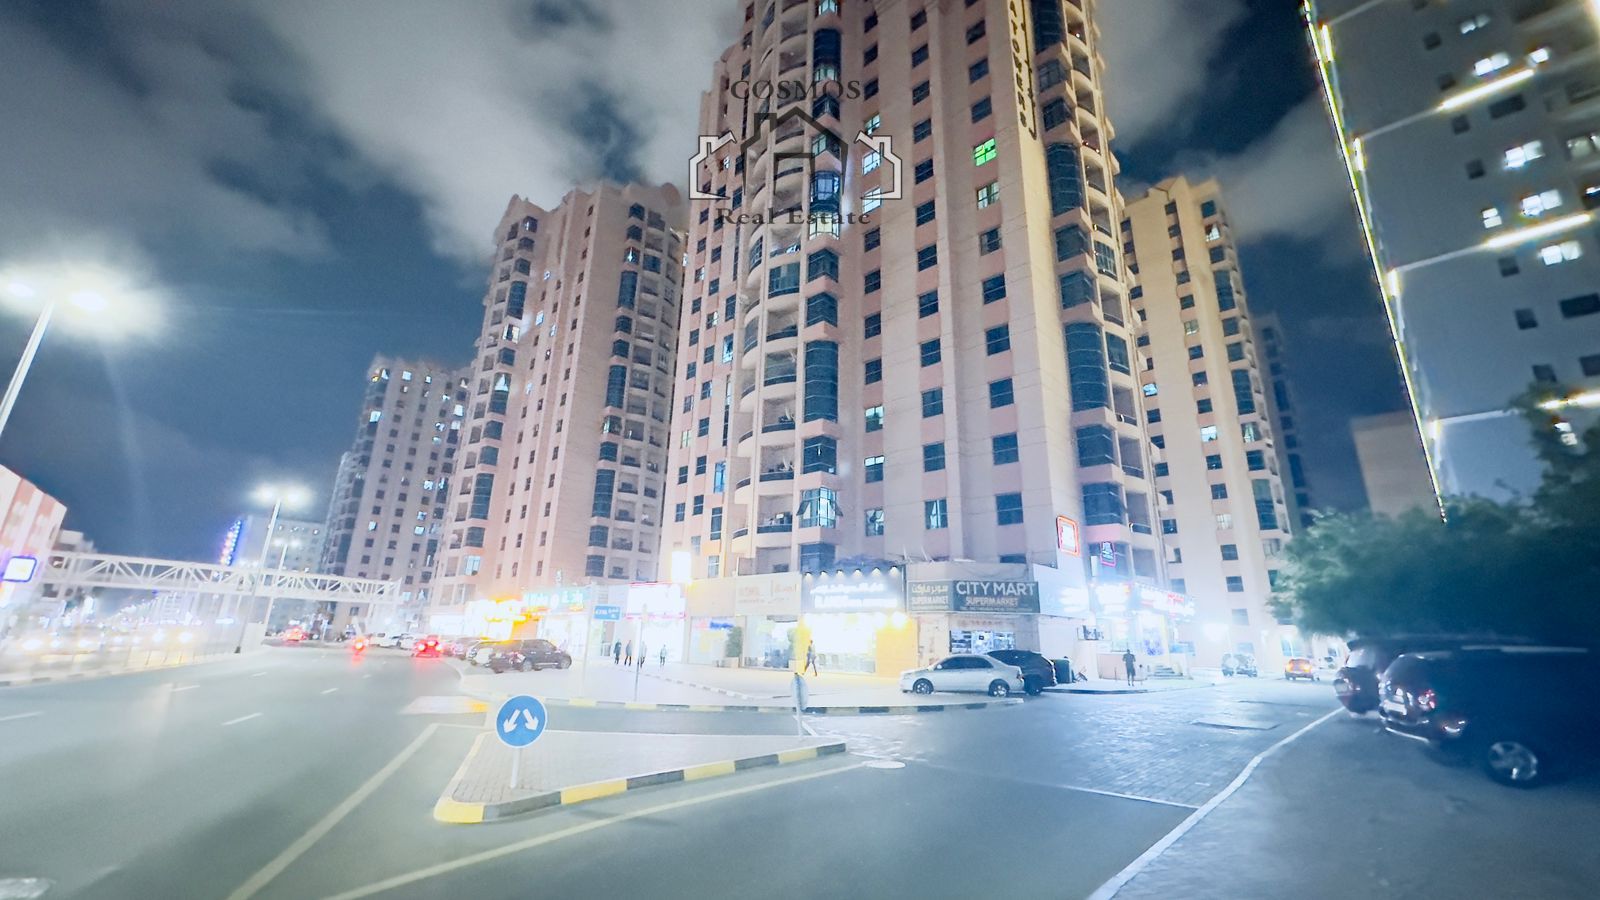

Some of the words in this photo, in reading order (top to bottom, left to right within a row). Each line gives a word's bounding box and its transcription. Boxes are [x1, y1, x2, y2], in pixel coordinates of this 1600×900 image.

[956, 581, 990, 595] CITY
[993, 582, 1035, 596] MART
[911, 595, 949, 605] SUPERMARKET
[965, 596, 1018, 607] SUPERMARKET
